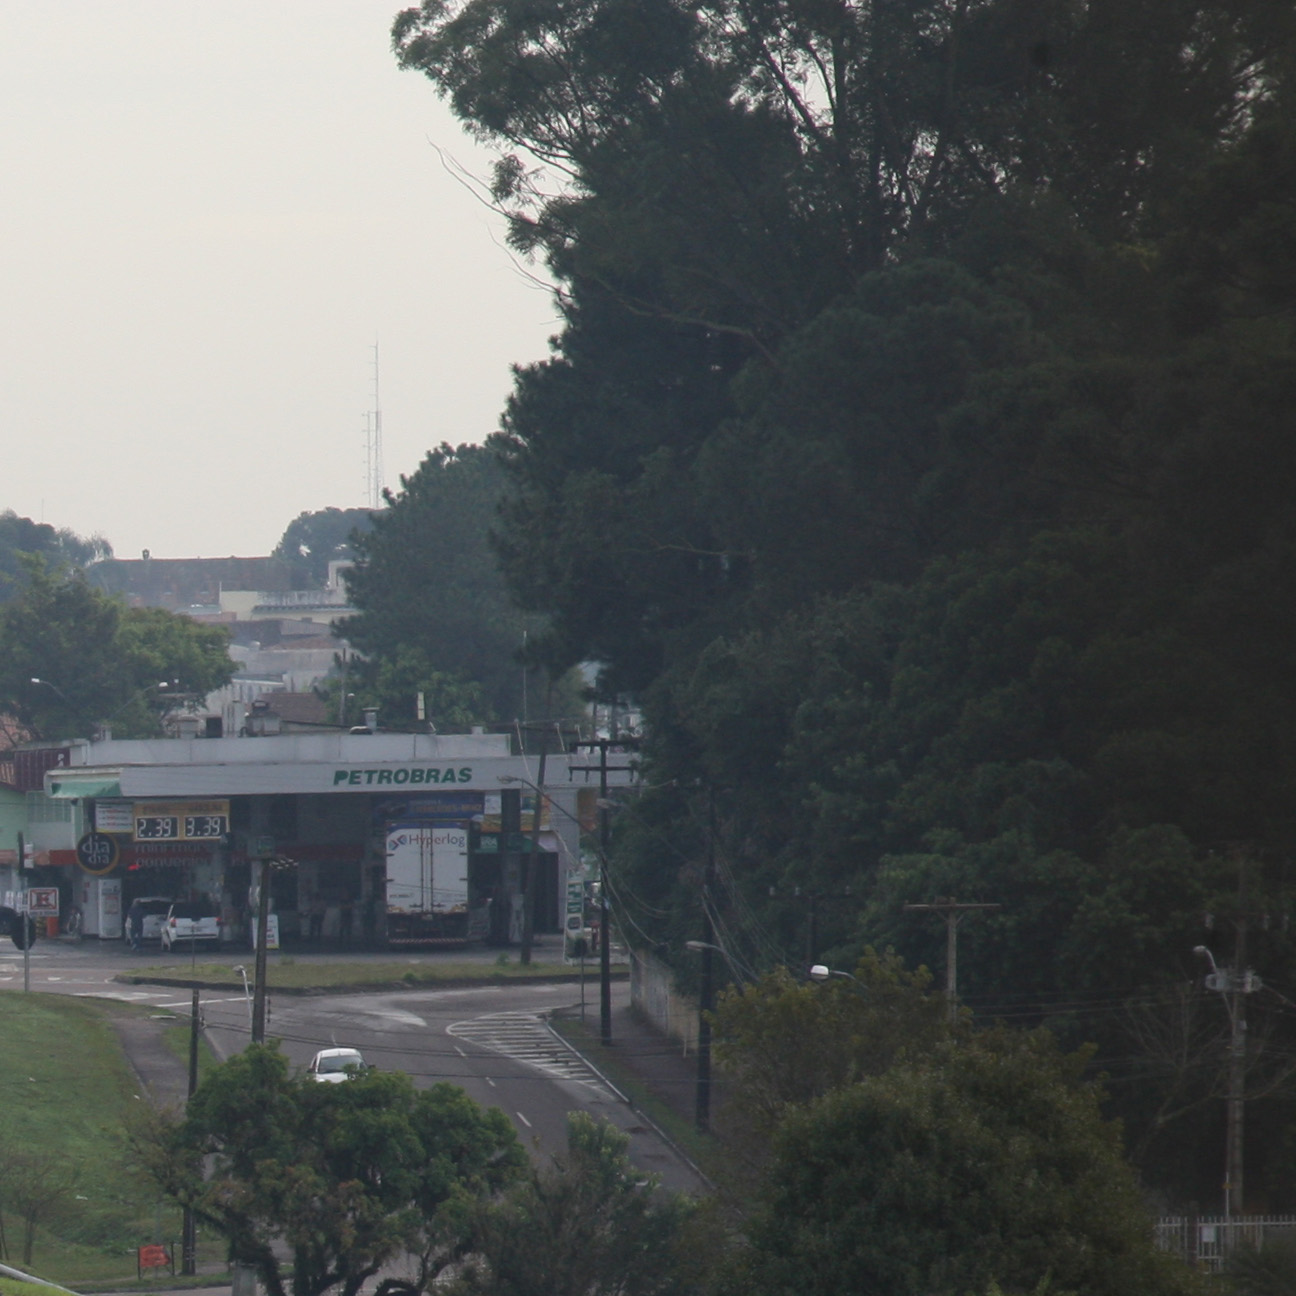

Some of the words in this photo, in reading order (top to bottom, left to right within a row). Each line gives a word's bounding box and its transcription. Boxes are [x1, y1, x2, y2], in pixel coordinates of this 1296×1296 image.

[333, 767, 473, 785] PETROBRAS
[137, 819, 172, 837] 2.39
[408, 829, 466, 849] Hyperlog
